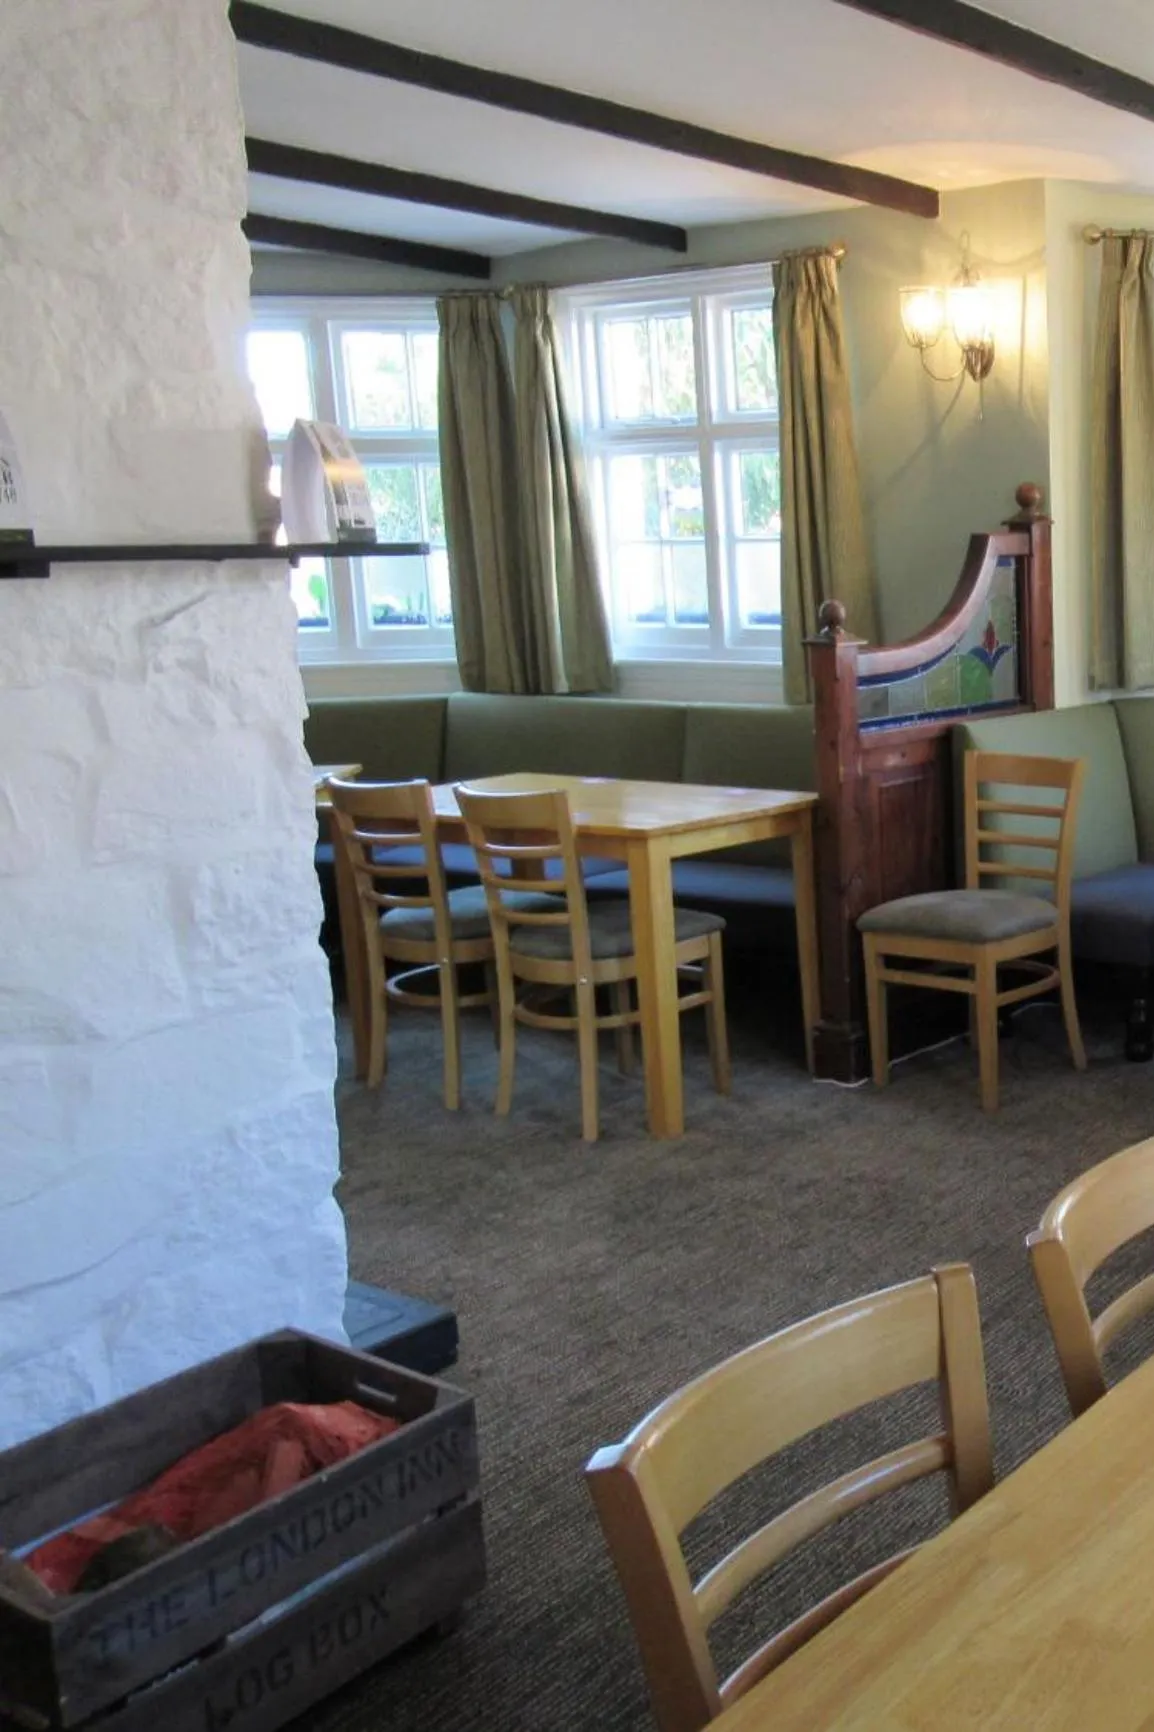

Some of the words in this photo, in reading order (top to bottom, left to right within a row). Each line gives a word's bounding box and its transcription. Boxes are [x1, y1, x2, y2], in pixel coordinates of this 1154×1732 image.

[90, 1583, 189, 1655] THE
[206, 1472, 386, 1606] LONDON
[395, 1429, 465, 1501] INN
[203, 1645, 295, 1731] LOG
[307, 1585, 393, 1665] BOX
